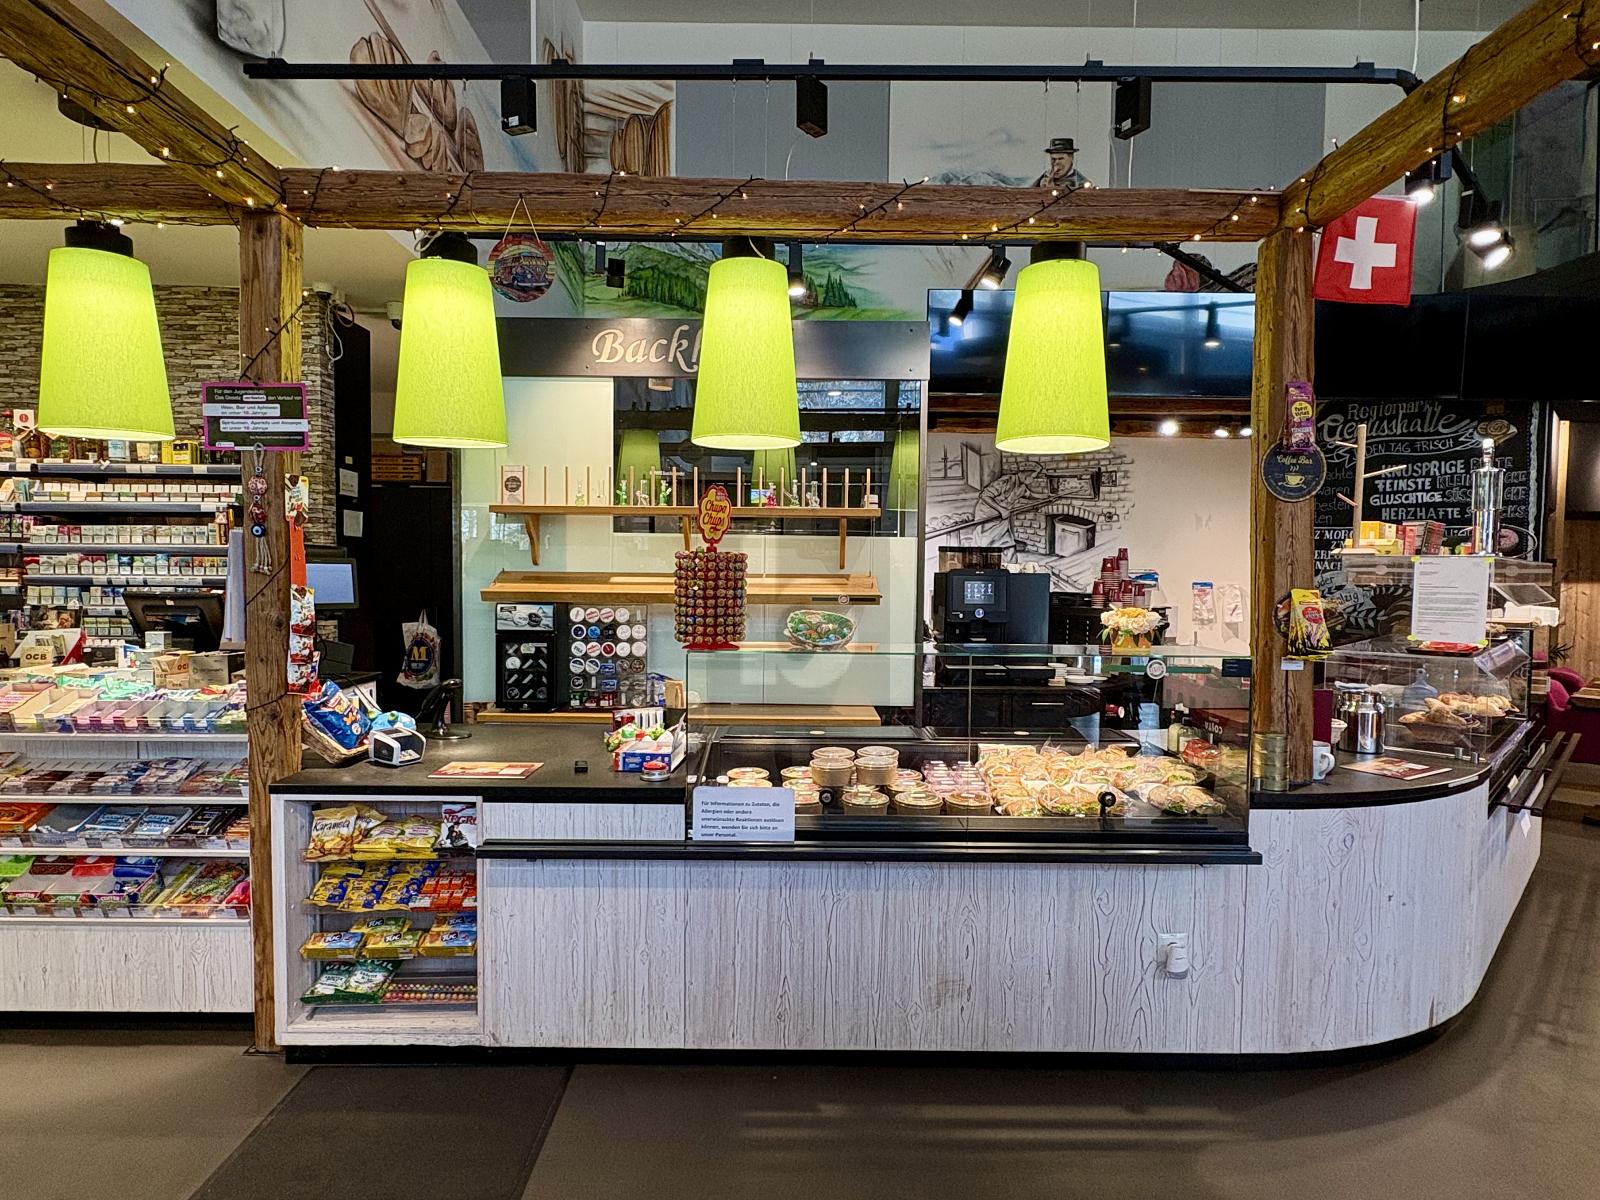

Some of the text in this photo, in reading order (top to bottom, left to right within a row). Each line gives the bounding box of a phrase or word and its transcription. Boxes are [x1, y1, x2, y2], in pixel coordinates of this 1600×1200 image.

[1318, 405, 1475, 442] Geusshalle
[1388, 442, 1411, 453] TAG
[1414, 439, 1454, 453] FRISCH
[1276, 455, 1313, 465] Coffee Bar
[1381, 459, 1466, 478] KNUSPRIGE
[1375, 477, 1432, 492] FEINSTE
[705, 500, 727, 515] Chupa
[1381, 507, 1460, 521] HERZHAFTE
[702, 512, 726, 527] Chups
[385, 934, 401, 942] TUC
[442, 933, 457, 941] TUC
